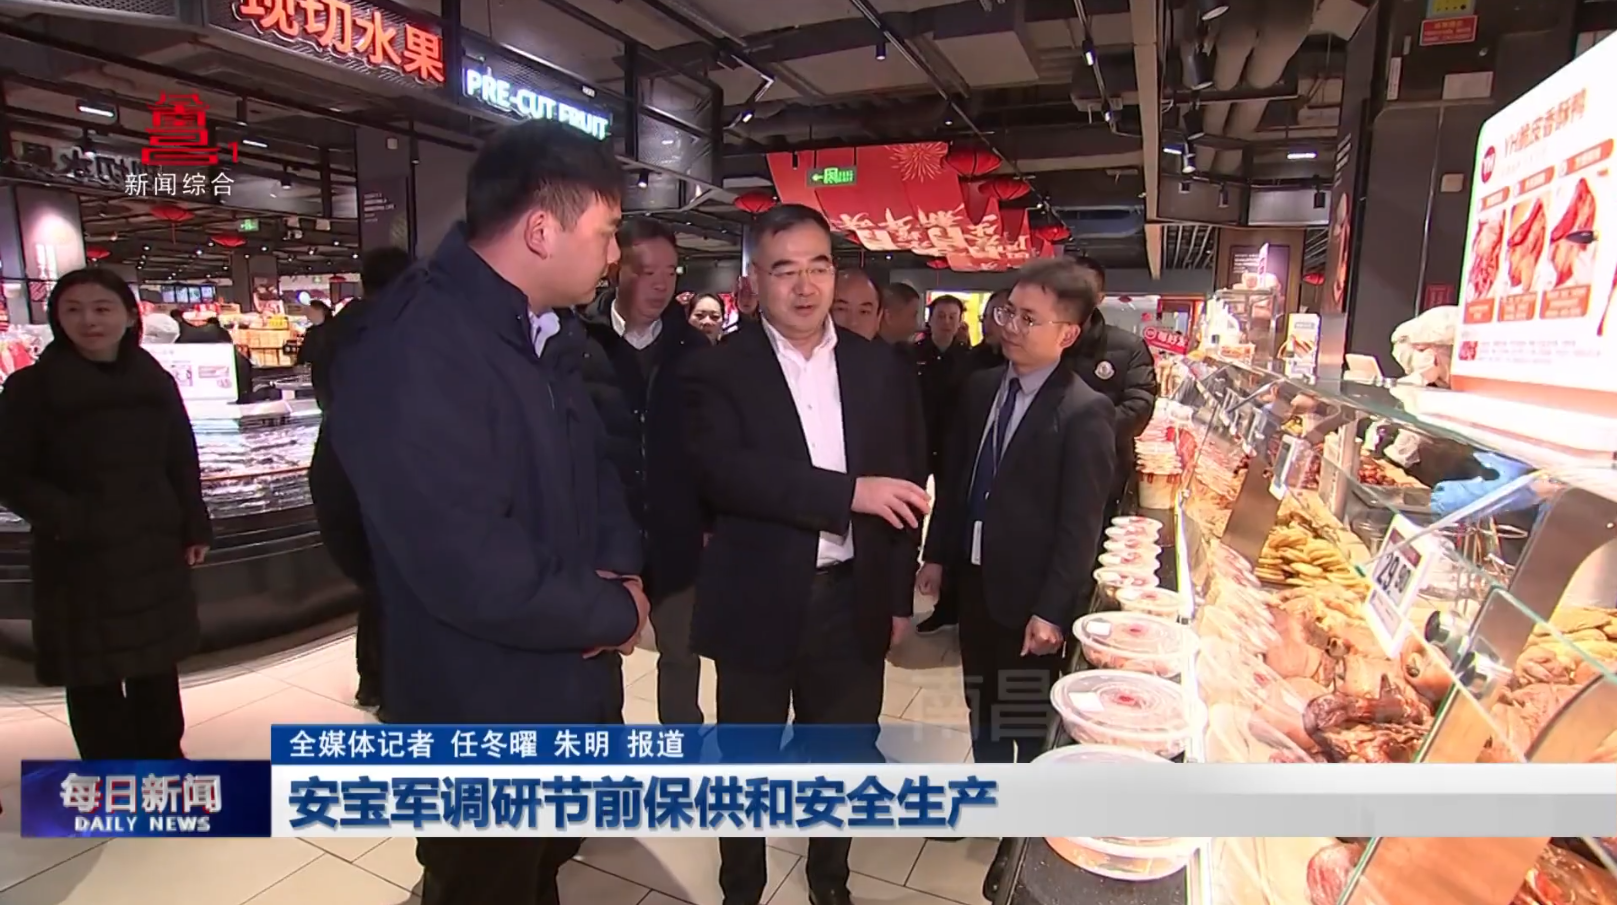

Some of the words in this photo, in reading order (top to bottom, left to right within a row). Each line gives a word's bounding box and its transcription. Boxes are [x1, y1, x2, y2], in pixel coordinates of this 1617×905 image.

[240, 0, 445, 82] 现切水果
[466, 69, 556, 120] PRE-CUT
[558, 102, 609, 141] FRUIT
